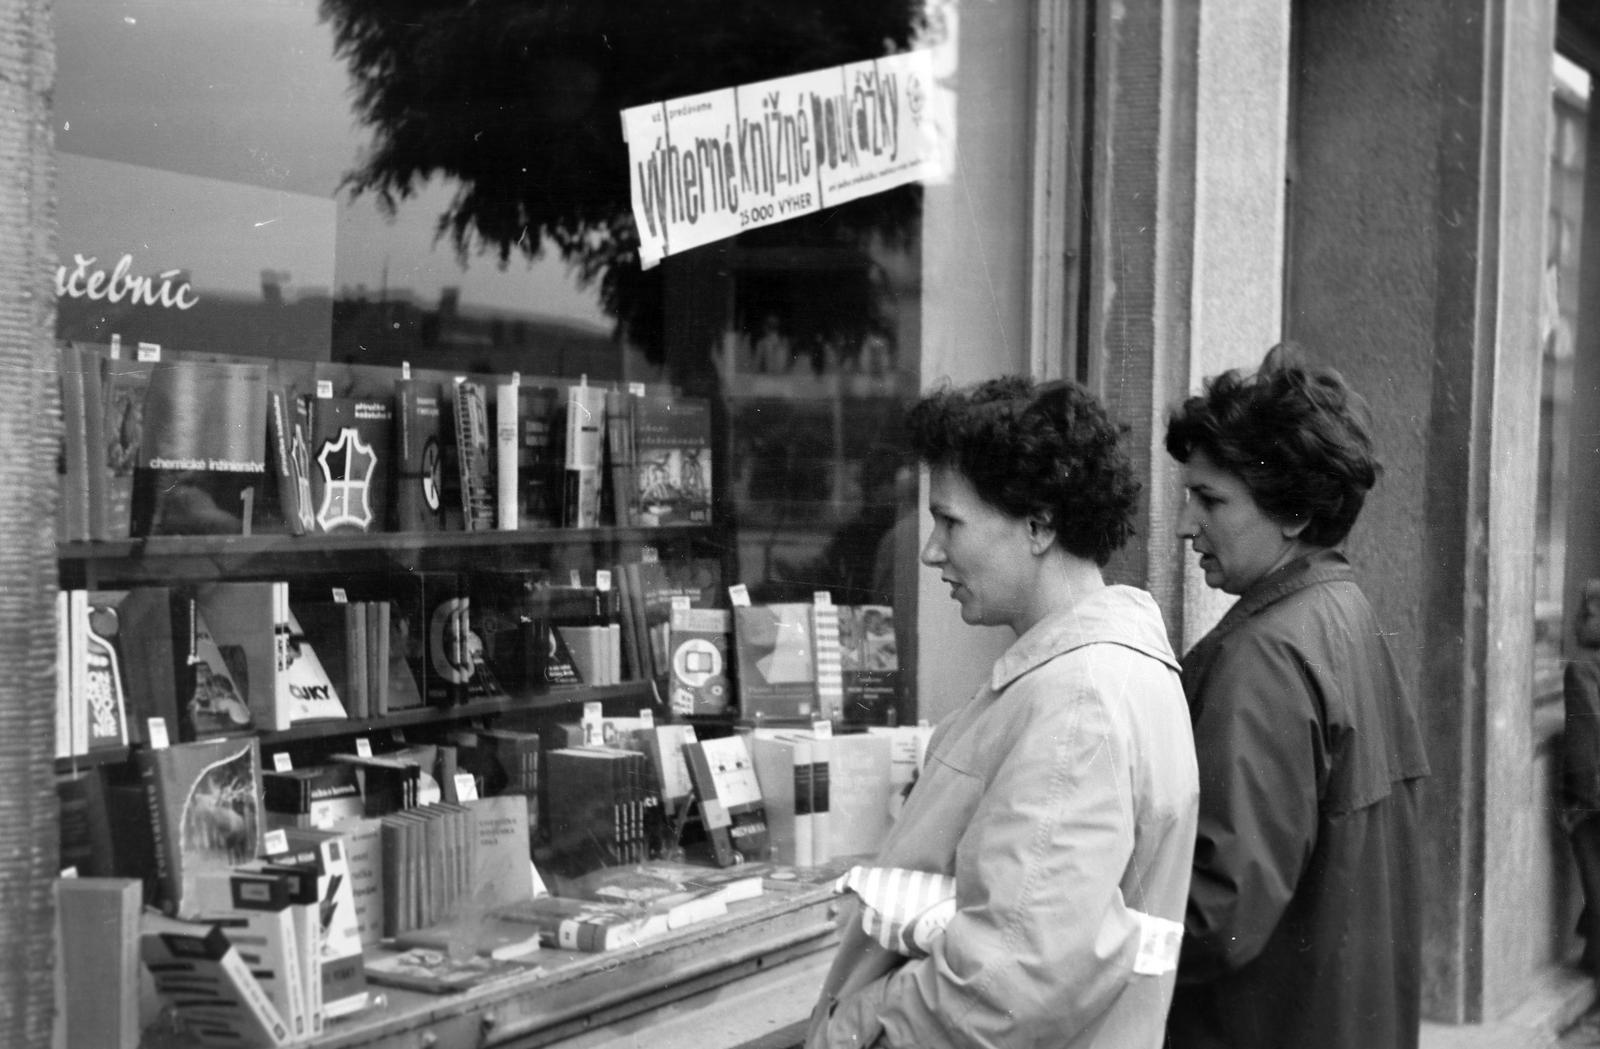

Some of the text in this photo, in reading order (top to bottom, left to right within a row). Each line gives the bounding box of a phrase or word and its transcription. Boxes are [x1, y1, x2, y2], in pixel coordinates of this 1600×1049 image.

[638, 70, 899, 252] výherné knižné poukážky
[778, 192, 812, 215] VÝHER
